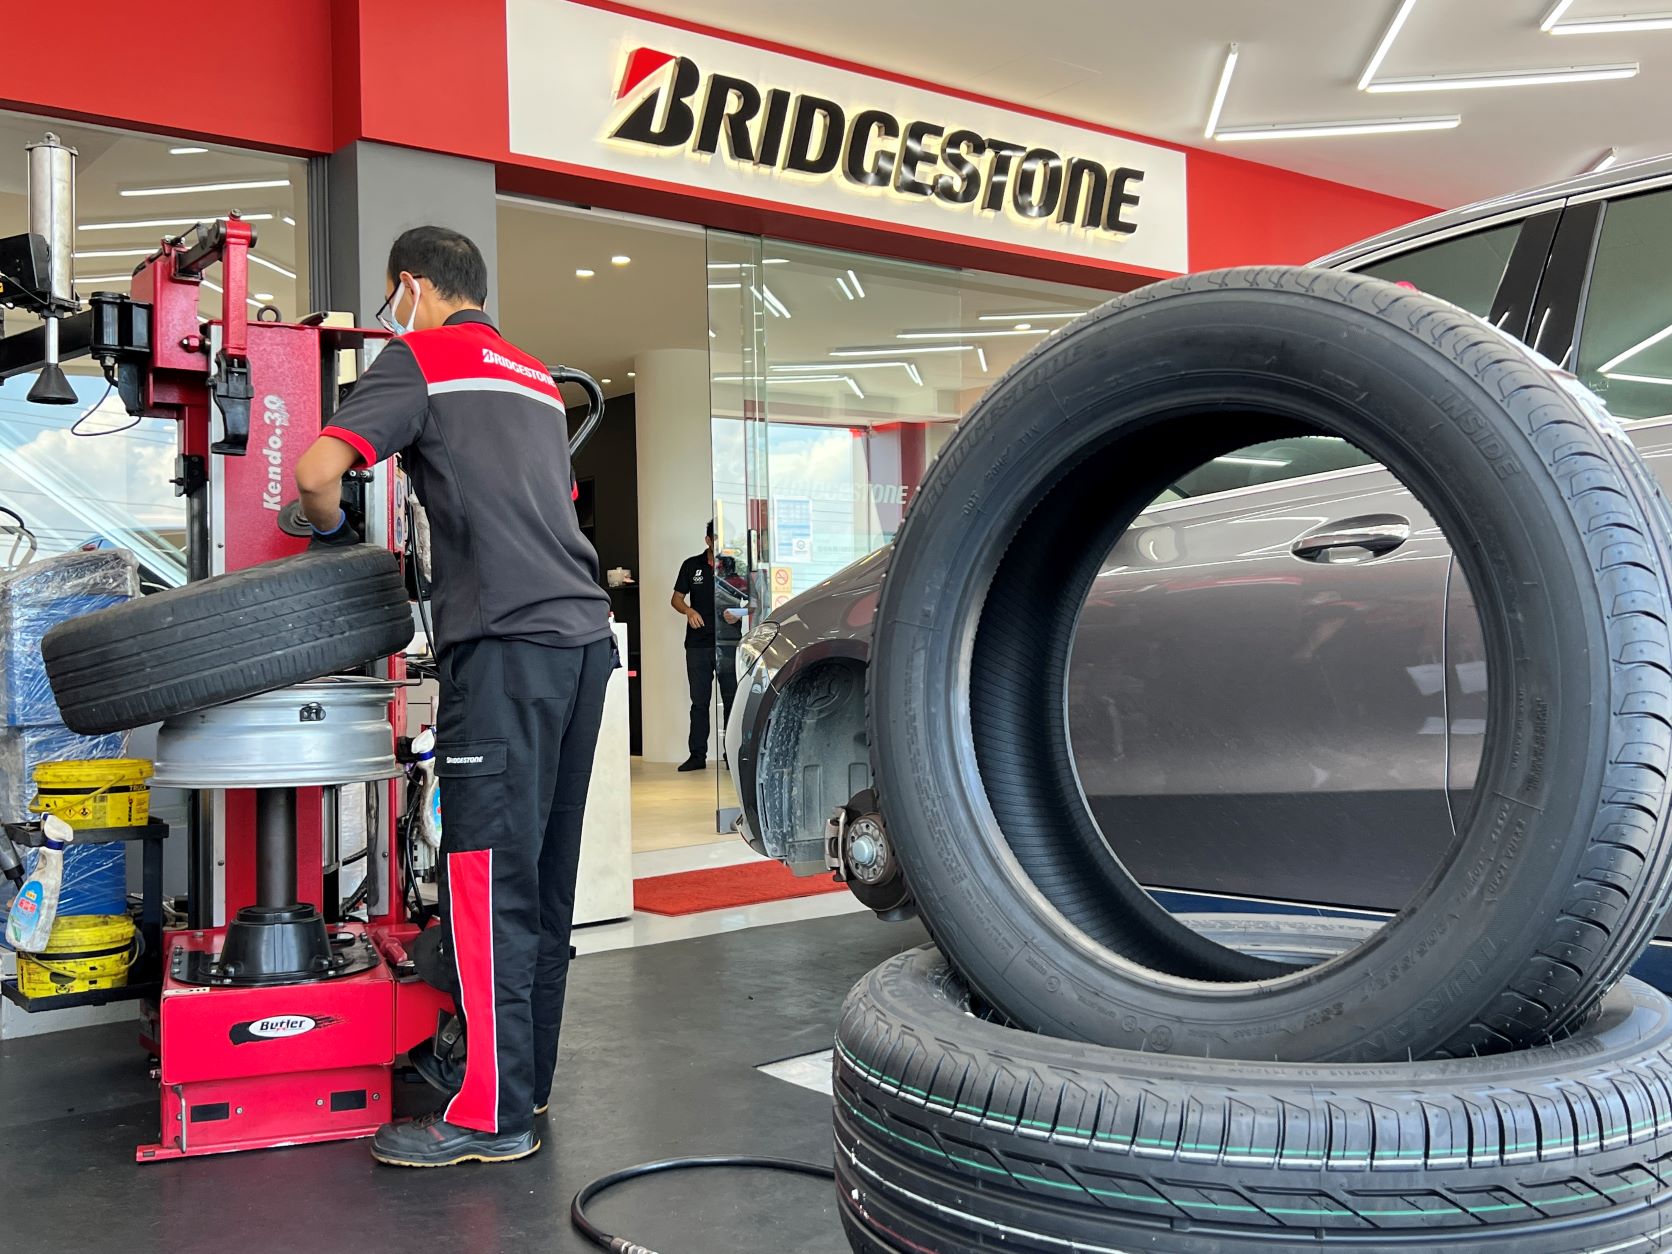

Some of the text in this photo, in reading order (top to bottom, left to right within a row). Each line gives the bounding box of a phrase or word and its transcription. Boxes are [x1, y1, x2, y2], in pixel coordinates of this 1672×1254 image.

[608, 46, 1145, 234] BRIDGESTONE
[1430, 382, 1521, 480] INSIDE
[446, 756, 484, 764] BRIDGESTONE
[260, 1019, 306, 1031] Butler
